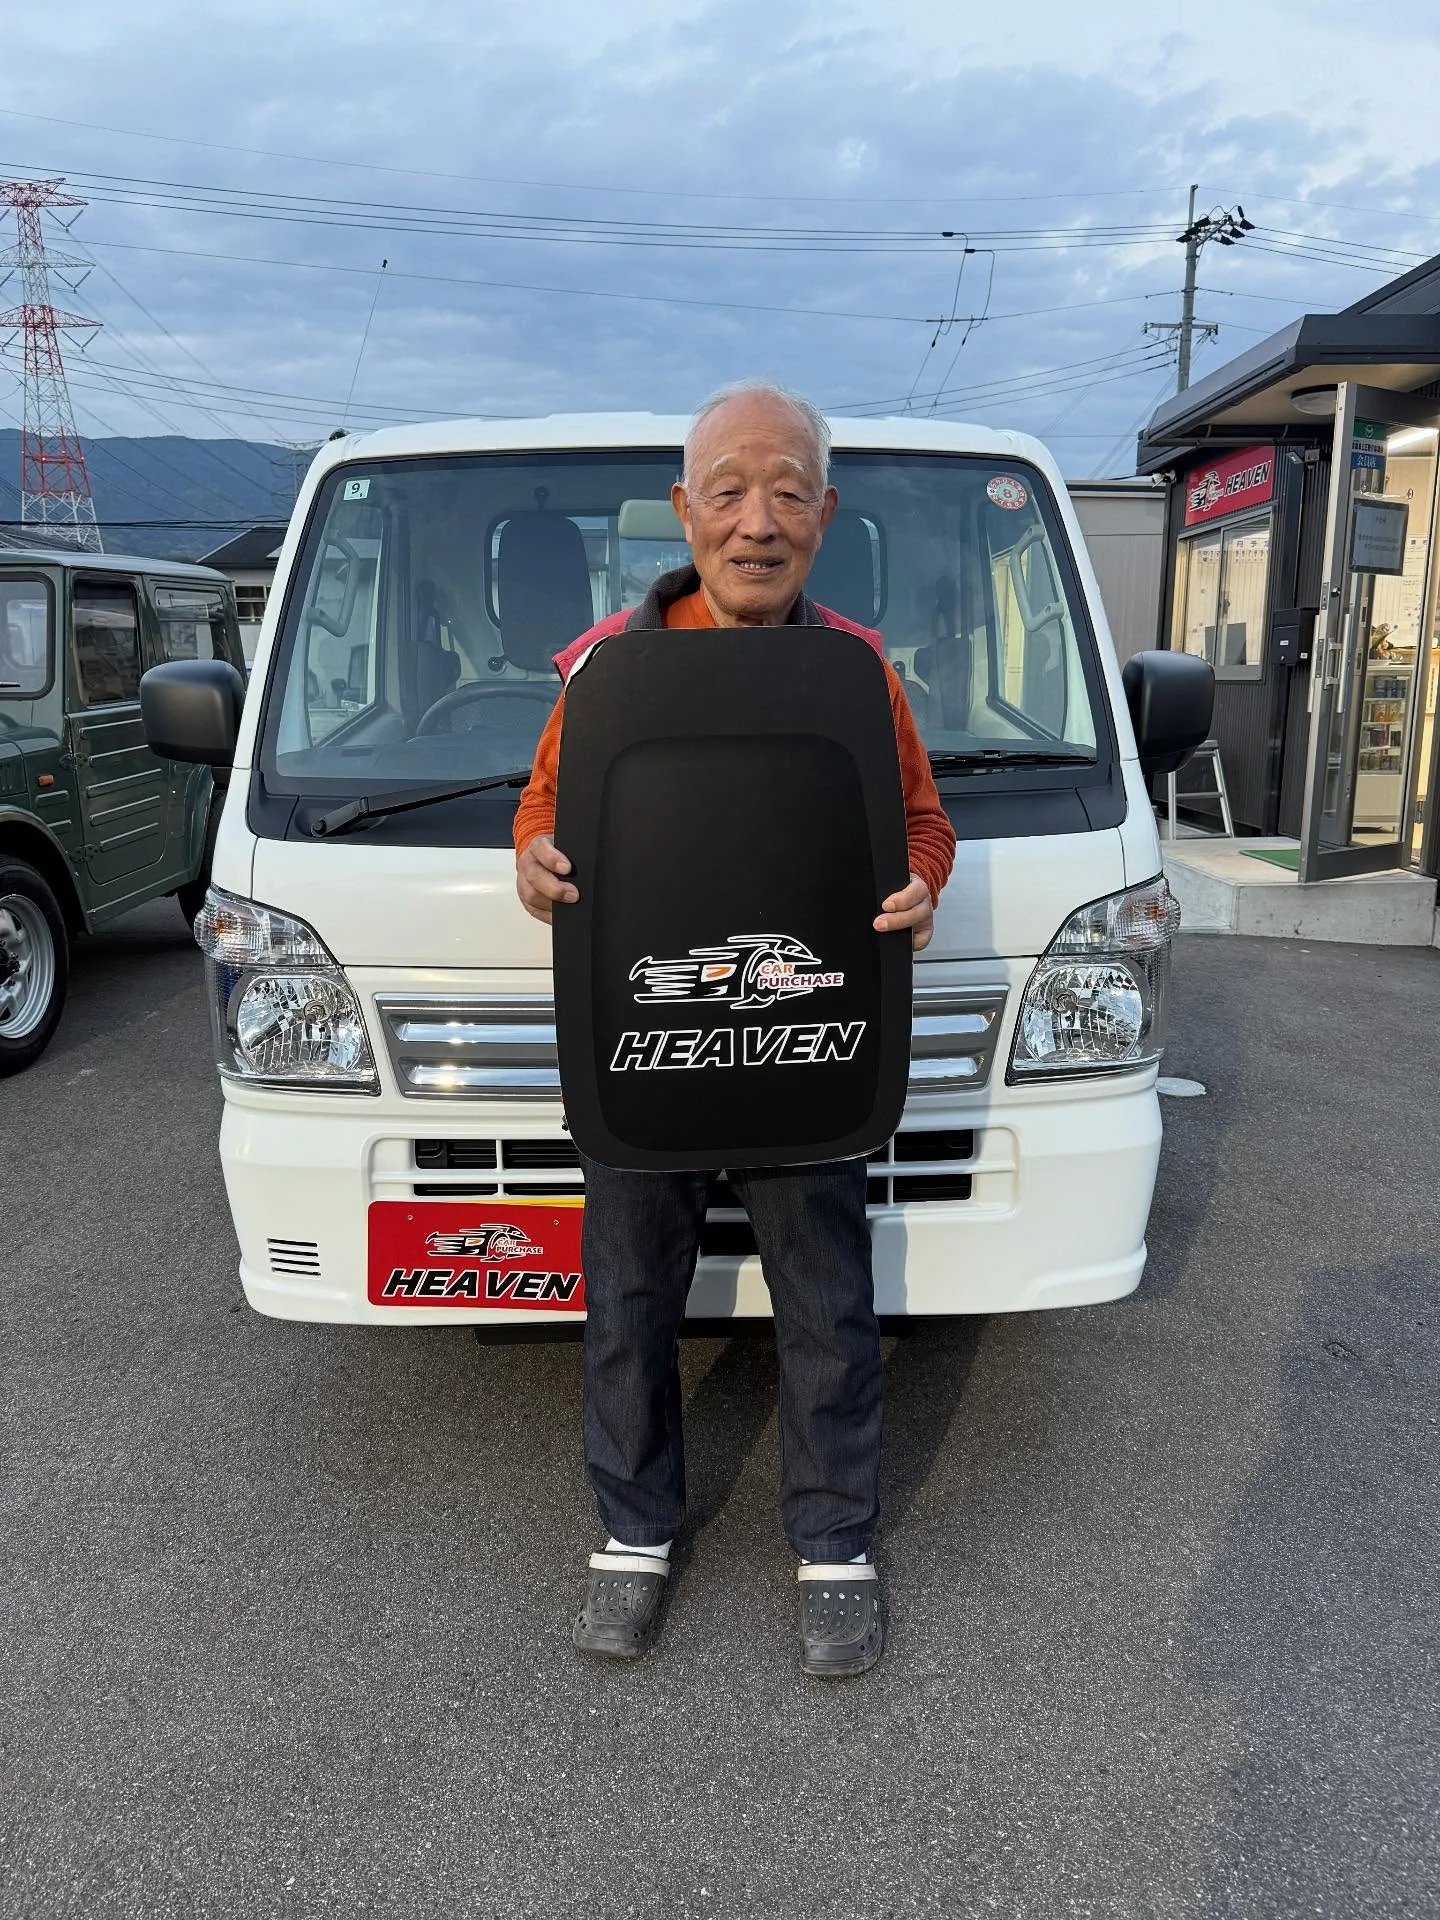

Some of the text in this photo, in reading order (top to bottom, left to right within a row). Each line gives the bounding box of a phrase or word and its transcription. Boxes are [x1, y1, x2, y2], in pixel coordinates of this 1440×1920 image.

[1224, 460, 1272, 497] HEAVEN
[352, 483, 360, 494] 9
[1003, 489, 1012, 498] 8
[759, 962, 795, 976] CAR
[757, 973, 844, 989] PURCHASE
[609, 1021, 867, 1072] HEAVEN
[497, 1238, 516, 1247] CAR
[496, 1246, 543, 1254] PURCHASE
[381, 1268, 581, 1301] HEAVEN
